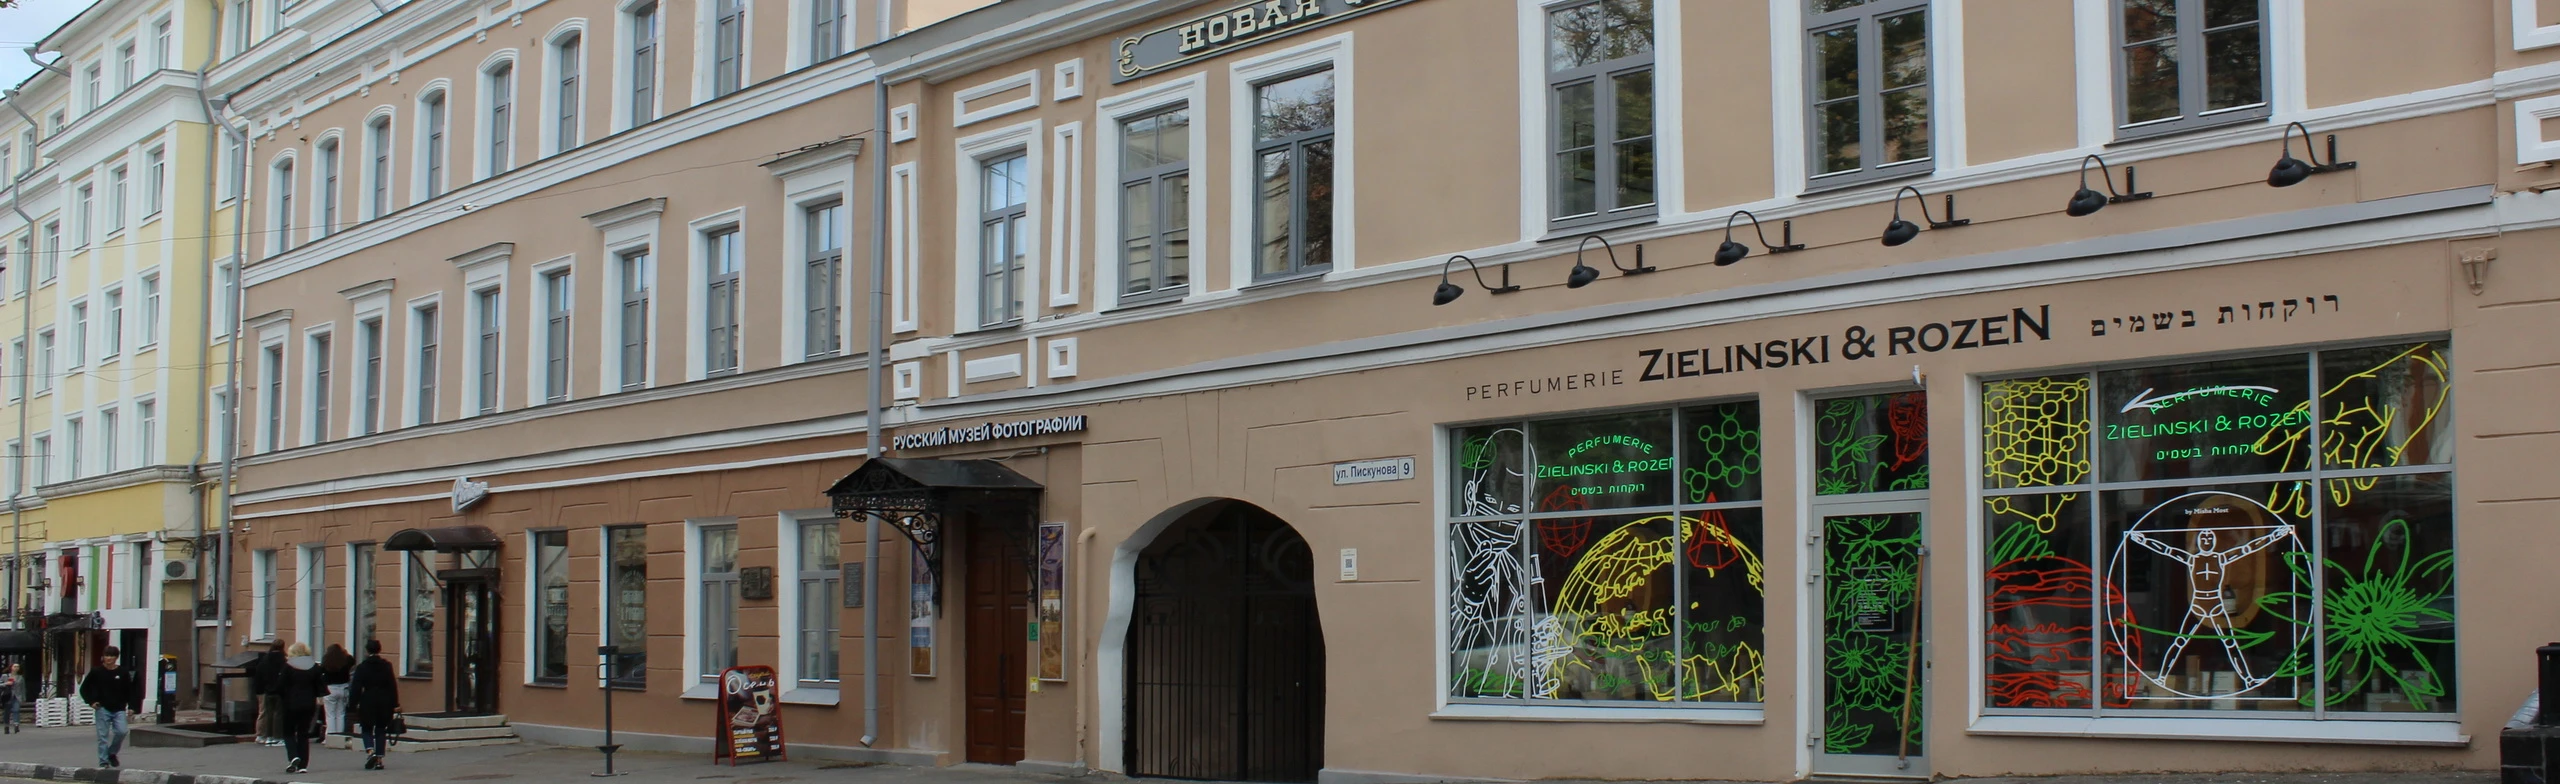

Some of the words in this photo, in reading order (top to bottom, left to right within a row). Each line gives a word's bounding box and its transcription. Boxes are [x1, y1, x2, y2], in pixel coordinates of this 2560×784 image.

[1178, 0, 1320, 53] НОВАЯ
[2090, 309, 2196, 337] בשמים
[2217, 294, 2339, 324] רוקחות
[1466, 369, 1623, 401] PERFUMERIE
[1637, 334, 1830, 382] ZIELINSKI
[1841, 325, 1875, 360] &
[1887, 304, 2051, 356] ROZEN
[2150, 385, 2273, 415] PERFUMERIE
[893, 427, 947, 451] РУССКИЙ
[948, 422, 990, 444] МУЗЕЙ
[992, 415, 1082, 439] ФОТОГРАФИИ
[2106, 419, 2208, 440] ZIELINSKI
[2214, 415, 2232, 432] &
[1568, 434, 1653, 459] PERFUMERIE
[1336, 469, 1348, 482] ул.
[1350, 464, 1397, 478] Пискунова
[1403, 462, 1410, 475] 9
[1537, 463, 1608, 478] ZIELINSKI
[1612, 459, 1625, 474] &
[2184, 508, 2193, 516] by
